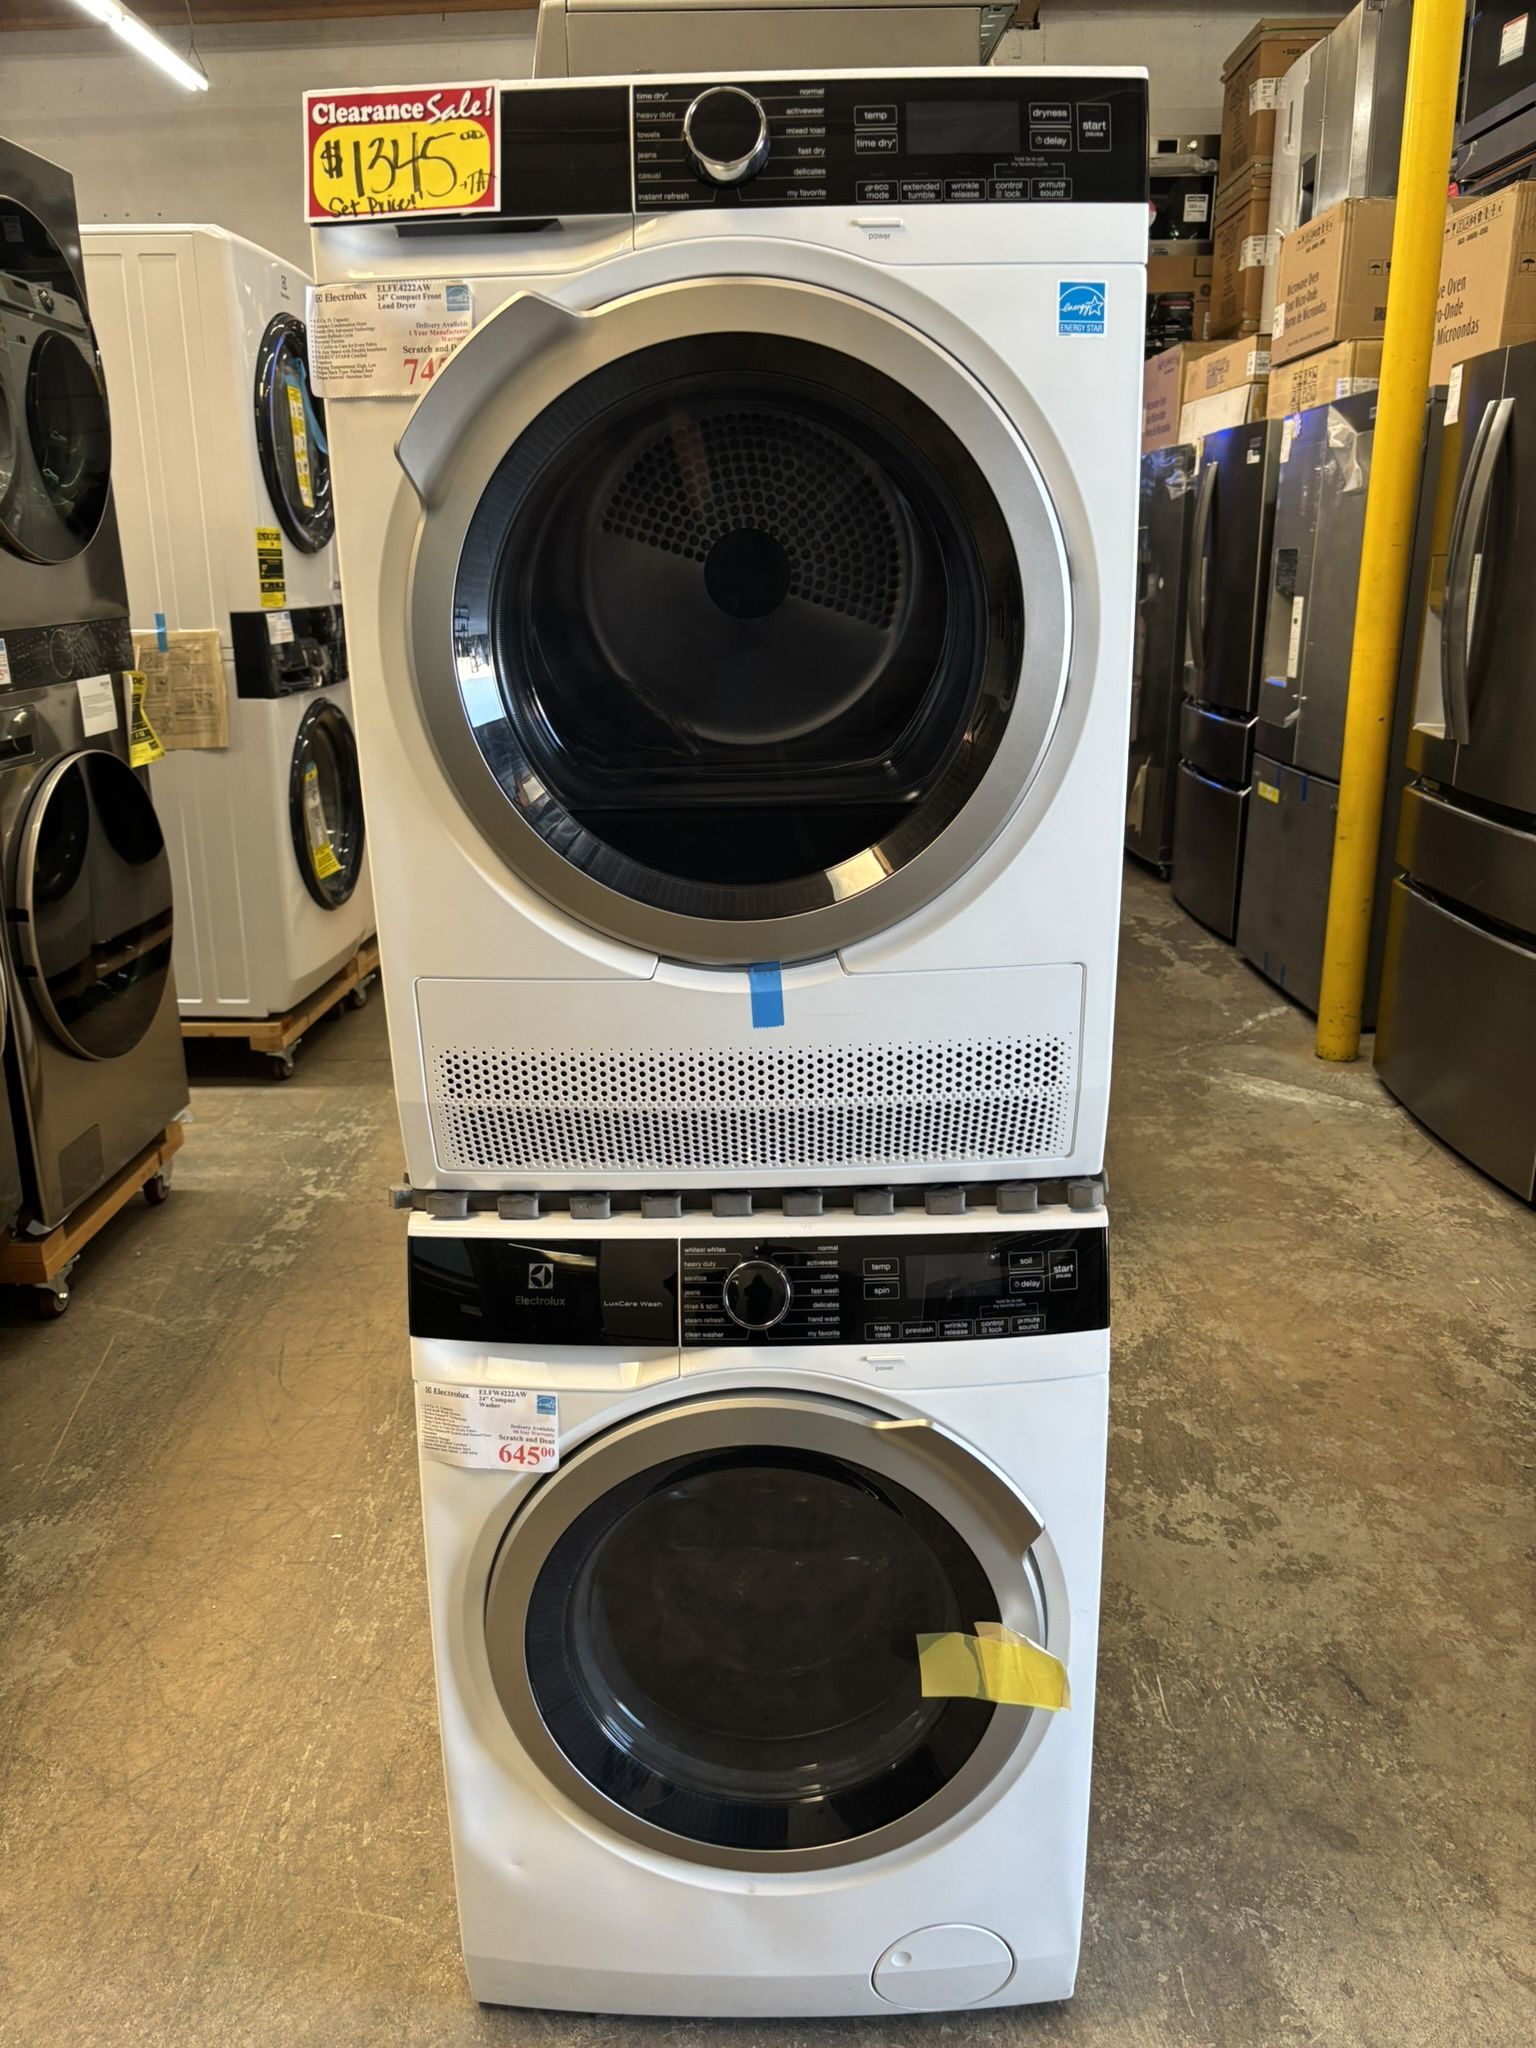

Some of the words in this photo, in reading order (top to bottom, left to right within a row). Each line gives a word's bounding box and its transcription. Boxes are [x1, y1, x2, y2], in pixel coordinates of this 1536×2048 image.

[636, 92, 652, 100] time
[312, 102, 424, 125] Clearance
[426, 87, 493, 125] Sale!
[636, 112, 658, 120] heavy
[659, 111, 676, 120] duty
[786, 107, 825, 115] activewear
[1032, 108, 1068, 119] dryness
[864, 111, 887, 122] temp
[1082, 120, 1106, 130] start
[636, 131, 661, 139] towels
[786, 127, 808, 135] mixed
[856, 138, 876, 148] time
[1044, 136, 1068, 146] delay
[637, 152, 658, 160] jeans
[812, 148, 826, 156] dry
[793, 168, 826, 176] delicates
[874, 183, 889, 192] eco
[902, 182, 940, 192] extended
[951, 182, 980, 190] wrinkle
[995, 182, 1023, 190] control
[638, 192, 664, 201] instant
[666, 192, 690, 200] refresh
[787, 190, 798, 198] my
[798, 189, 827, 197] favorite
[866, 190, 890, 200] mode
[908, 190, 936, 200] tumble
[951, 190, 980, 199] release
[1004, 190, 1021, 198] lock
[1040, 189, 1064, 197] sound
[328, 196, 361, 218] Set
[868, 232, 891, 242] power
[377, 284, 432, 293] ELFE4222AW
[1447, 276, 1466, 297] Oven
[324, 292, 368, 303] Electrolux
[390, 294, 422, 302] Compact
[378, 302, 395, 310] Load
[396, 302, 416, 312] Dryer
[416, 322, 440, 330] Delivery
[1060, 324, 1086, 332] ENERGY
[1086, 324, 1103, 332] STAR
[1436, 316, 1480, 346] Microondas
[440, 334, 466, 342] Warran
[402, 345, 434, 354] Scratch
[434, 344, 450, 354] and
[403, 358, 448, 385] 74
[684, 1260, 702, 1268] heavy
[1019, 1256, 1033, 1264] soil
[871, 1262, 891, 1272] temp
[1053, 1264, 1074, 1273] start
[1020, 1279, 1041, 1290] delay
[874, 1286, 890, 1296] spin
[514, 1295, 566, 1307] Electrolux
[706, 1303, 719, 1311] spin
[980, 1320, 1004, 1328] control
[1024, 1316, 1041, 1324] mute
[874, 1324, 892, 1332] fresh
[905, 1325, 934, 1336] prewash
[944, 1322, 968, 1330] wrinkle
[988, 1326, 1003, 1334] lock
[1018, 1322, 1040, 1331] sound
[874, 1331, 892, 1339] rinse
[944, 1328, 968, 1336] release
[875, 1364, 894, 1372] power
[433, 1388, 470, 1399] Electrolux
[478, 1389, 528, 1398] ELFW4222AW
